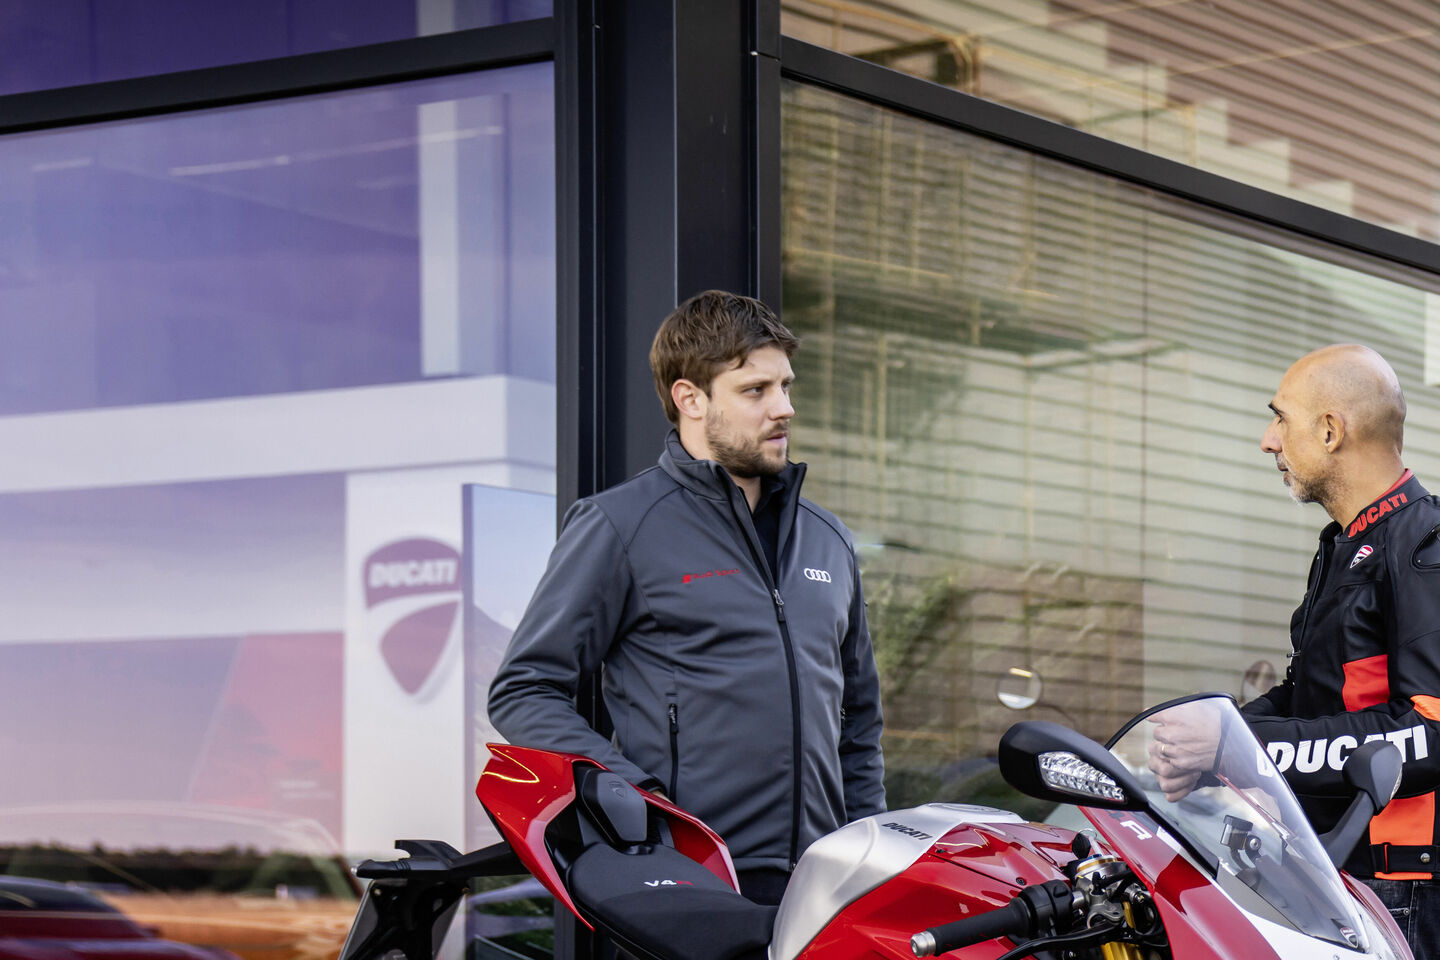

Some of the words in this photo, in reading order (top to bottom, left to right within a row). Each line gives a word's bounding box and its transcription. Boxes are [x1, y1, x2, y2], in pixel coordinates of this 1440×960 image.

[1347, 492, 1409, 538] DUCATI
[368, 558, 457, 588] DUCATI
[1257, 724, 1429, 777] DUCTI
[881, 822, 933, 840] DUCATI
